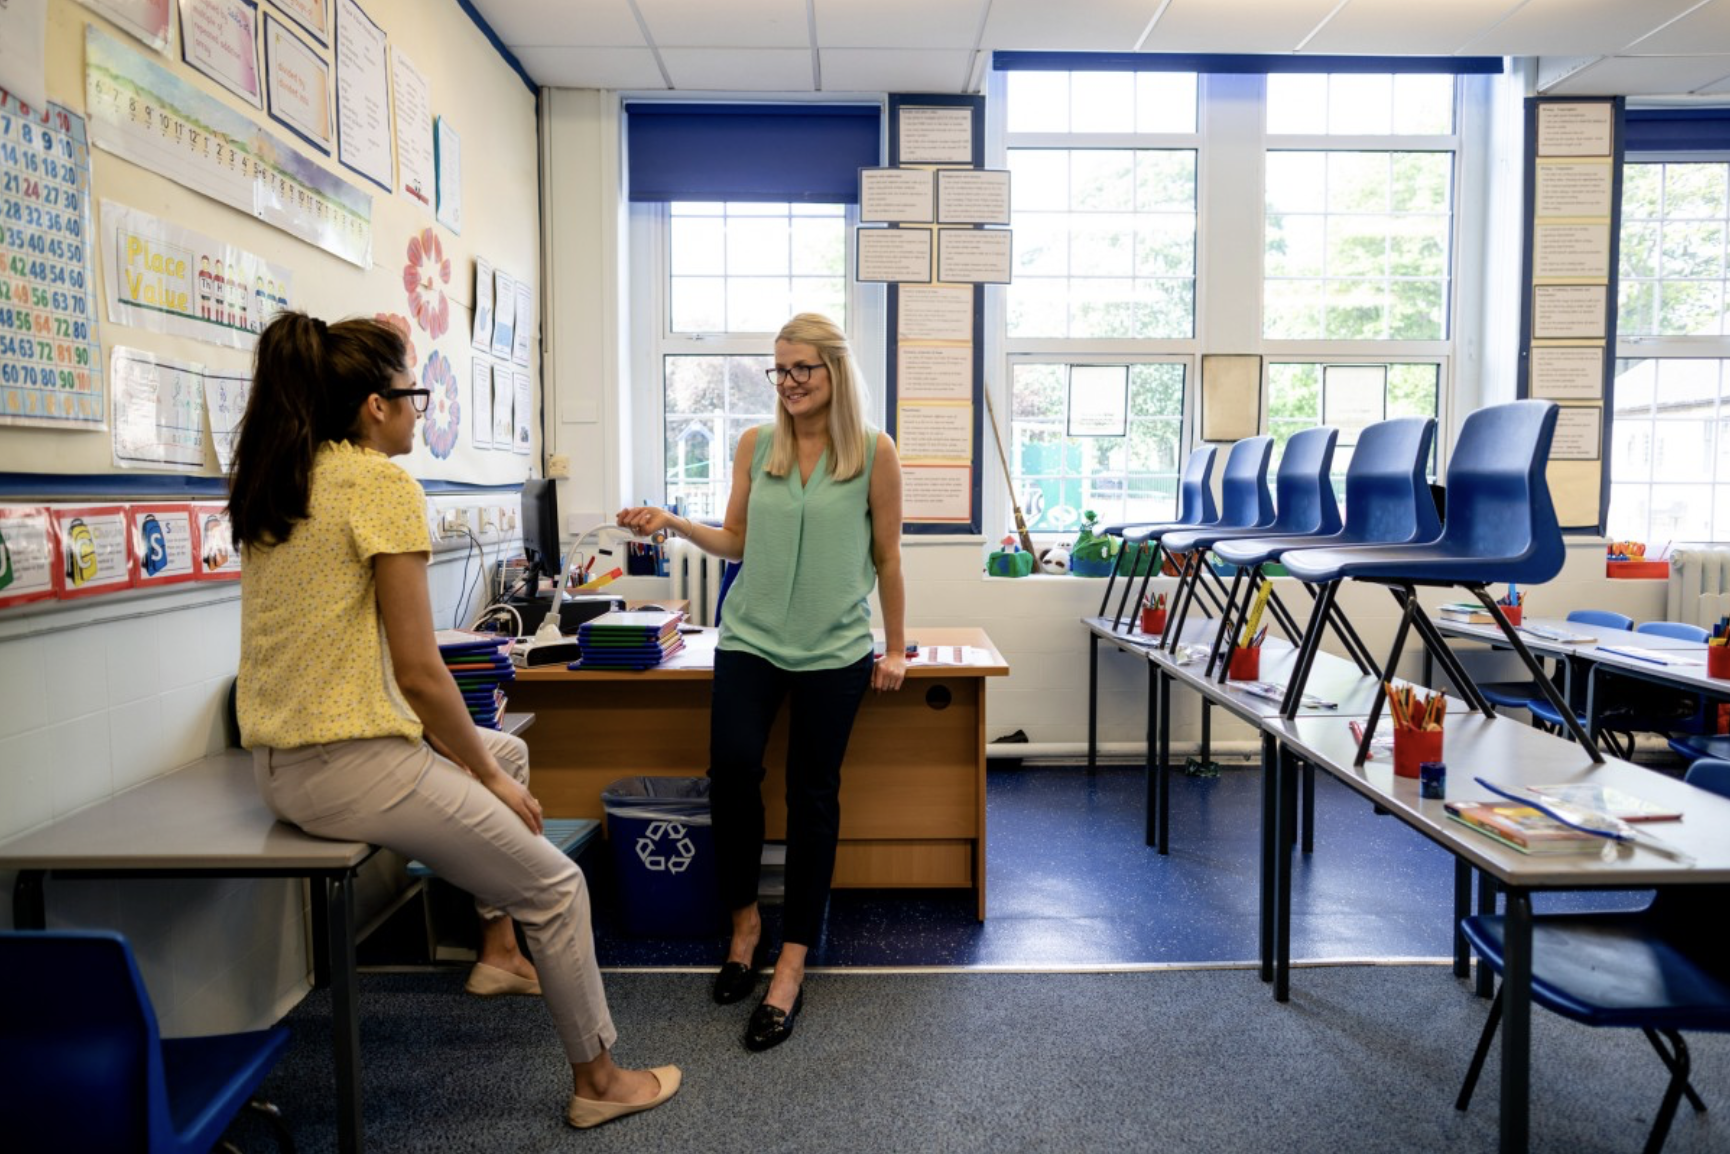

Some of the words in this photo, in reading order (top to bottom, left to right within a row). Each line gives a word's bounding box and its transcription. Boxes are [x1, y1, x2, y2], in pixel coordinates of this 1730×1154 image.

[56, 112, 70, 132] 10
[96, 80, 102, 93] 6
[129, 97, 136, 111] 8
[145, 105, 151, 119] 9
[160, 113, 169, 129] 10
[175, 121, 182, 136] 11
[189, 128, 198, 144] 12
[1, 115, 11, 134] 7
[22, 123, 33, 143] 8
[42, 131, 52, 150] 9
[59, 138, 72, 159] 10
[1, 143, 18, 165] 14
[23, 151, 38, 172] 16
[43, 158, 57, 178] 18
[61, 165, 75, 185] 20
[4, 171, 19, 194] 21
[23, 177, 40, 200] 24
[44, 185, 59, 205] 27
[64, 191, 77, 211] 30
[5, 199, 22, 221] 28
[25, 205, 42, 227] 32
[46, 211, 62, 232] 36
[66, 218, 79, 237] 40
[7, 227, 24, 248] 35
[28, 233, 45, 254] 40
[49, 239, 64, 258] 45
[67, 245, 81, 262] 50
[127, 235, 186, 279] Place
[10, 256, 27, 277] 42
[30, 261, 47, 281] 48
[50, 265, 65, 284] 54
[69, 269, 83, 289] 60
[201, 278, 211, 291] Th
[217, 283, 222, 293] H
[13, 283, 29, 304] 49
[32, 287, 49, 307] 56
[53, 291, 68, 311] 63
[71, 295, 85, 314] 70
[125, 268, 188, 312] Value
[16, 310, 32, 331] 56
[34, 313, 51, 334] 64
[55, 318, 70, 337] 72
[73, 321, 86, 340] 80
[0, 335, 16, 356] 54
[19, 339, 34, 358] 63
[37, 341, 53, 361] 72
[57, 345, 72, 364] 81
[75, 347, 88, 366] 90
[3, 363, 19, 383] 60
[21, 366, 37, 386] 70
[41, 368, 56, 387] 80
[59, 370, 74, 389] 90
[75, 538, 91, 569] C
[151, 533, 162, 561] S
